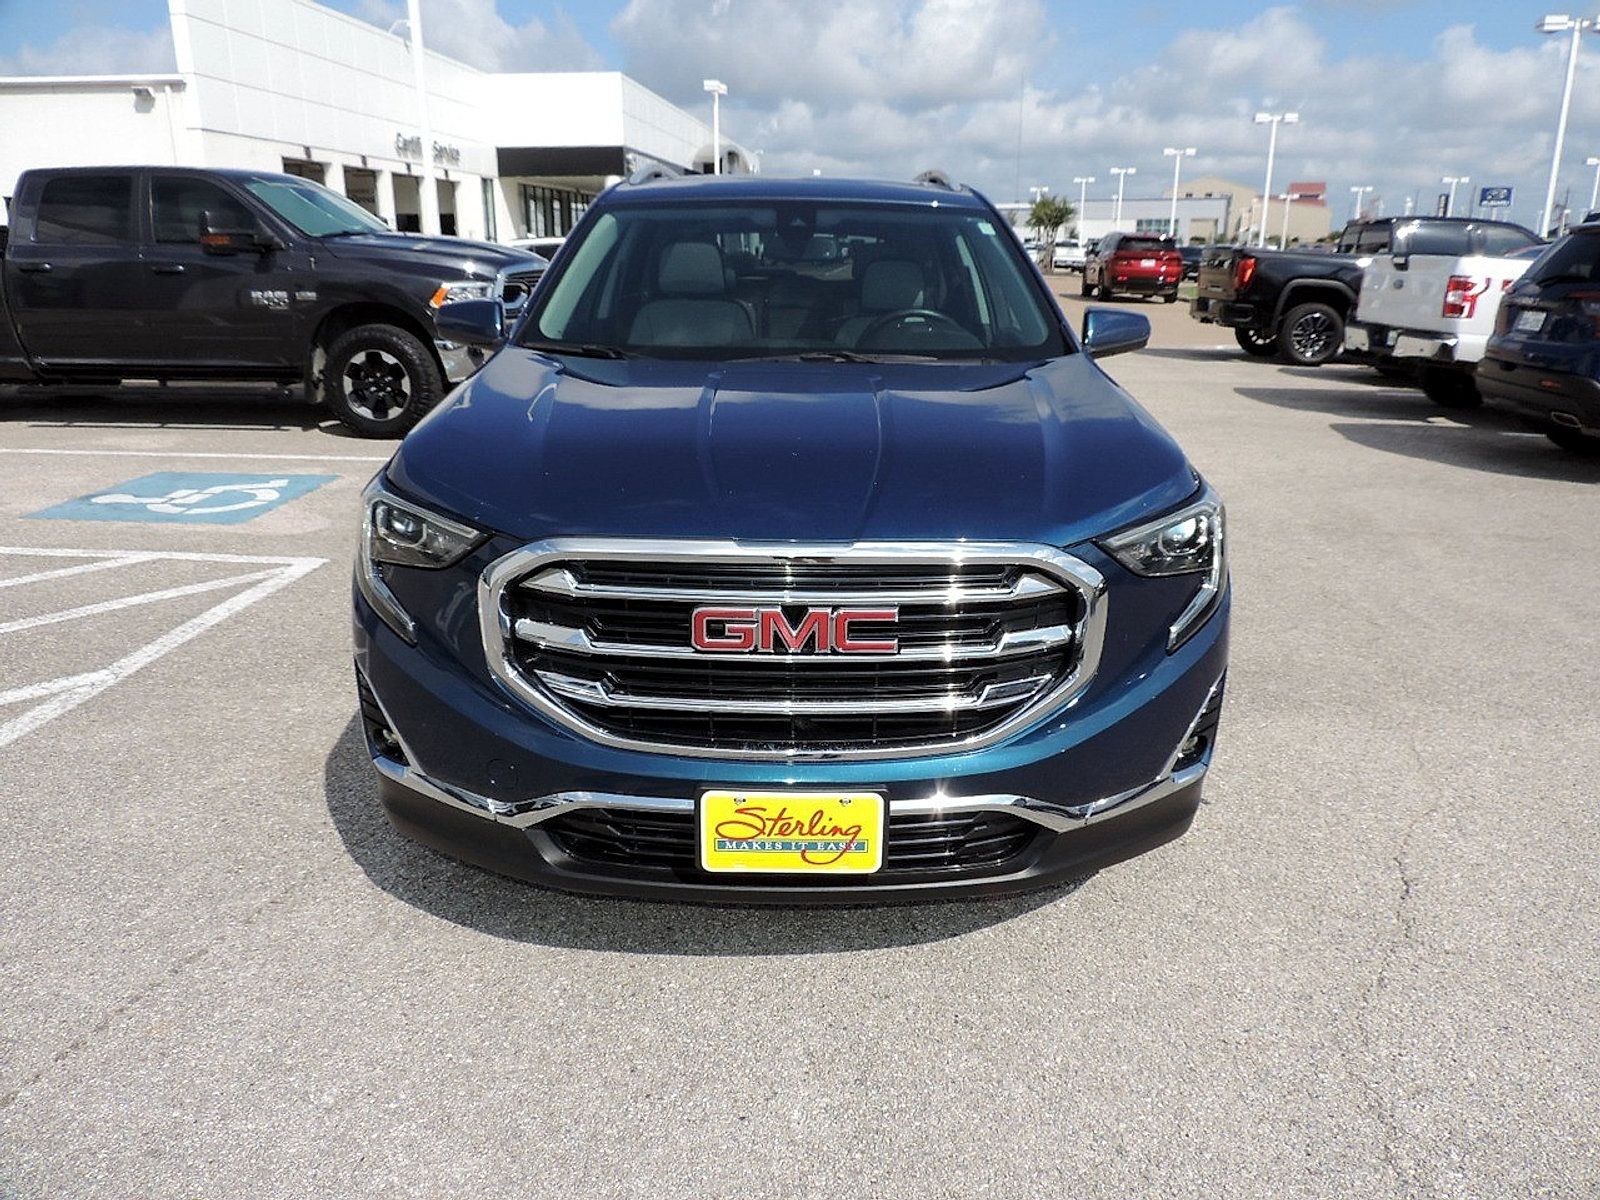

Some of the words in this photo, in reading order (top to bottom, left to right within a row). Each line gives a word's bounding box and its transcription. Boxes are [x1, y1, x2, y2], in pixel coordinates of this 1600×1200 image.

[691, 606, 899, 654] GMC
[715, 807, 862, 865] Sterling
[725, 840, 784, 850] MAKES
[791, 841, 809, 851] IT
[818, 841, 859, 851] EASY
